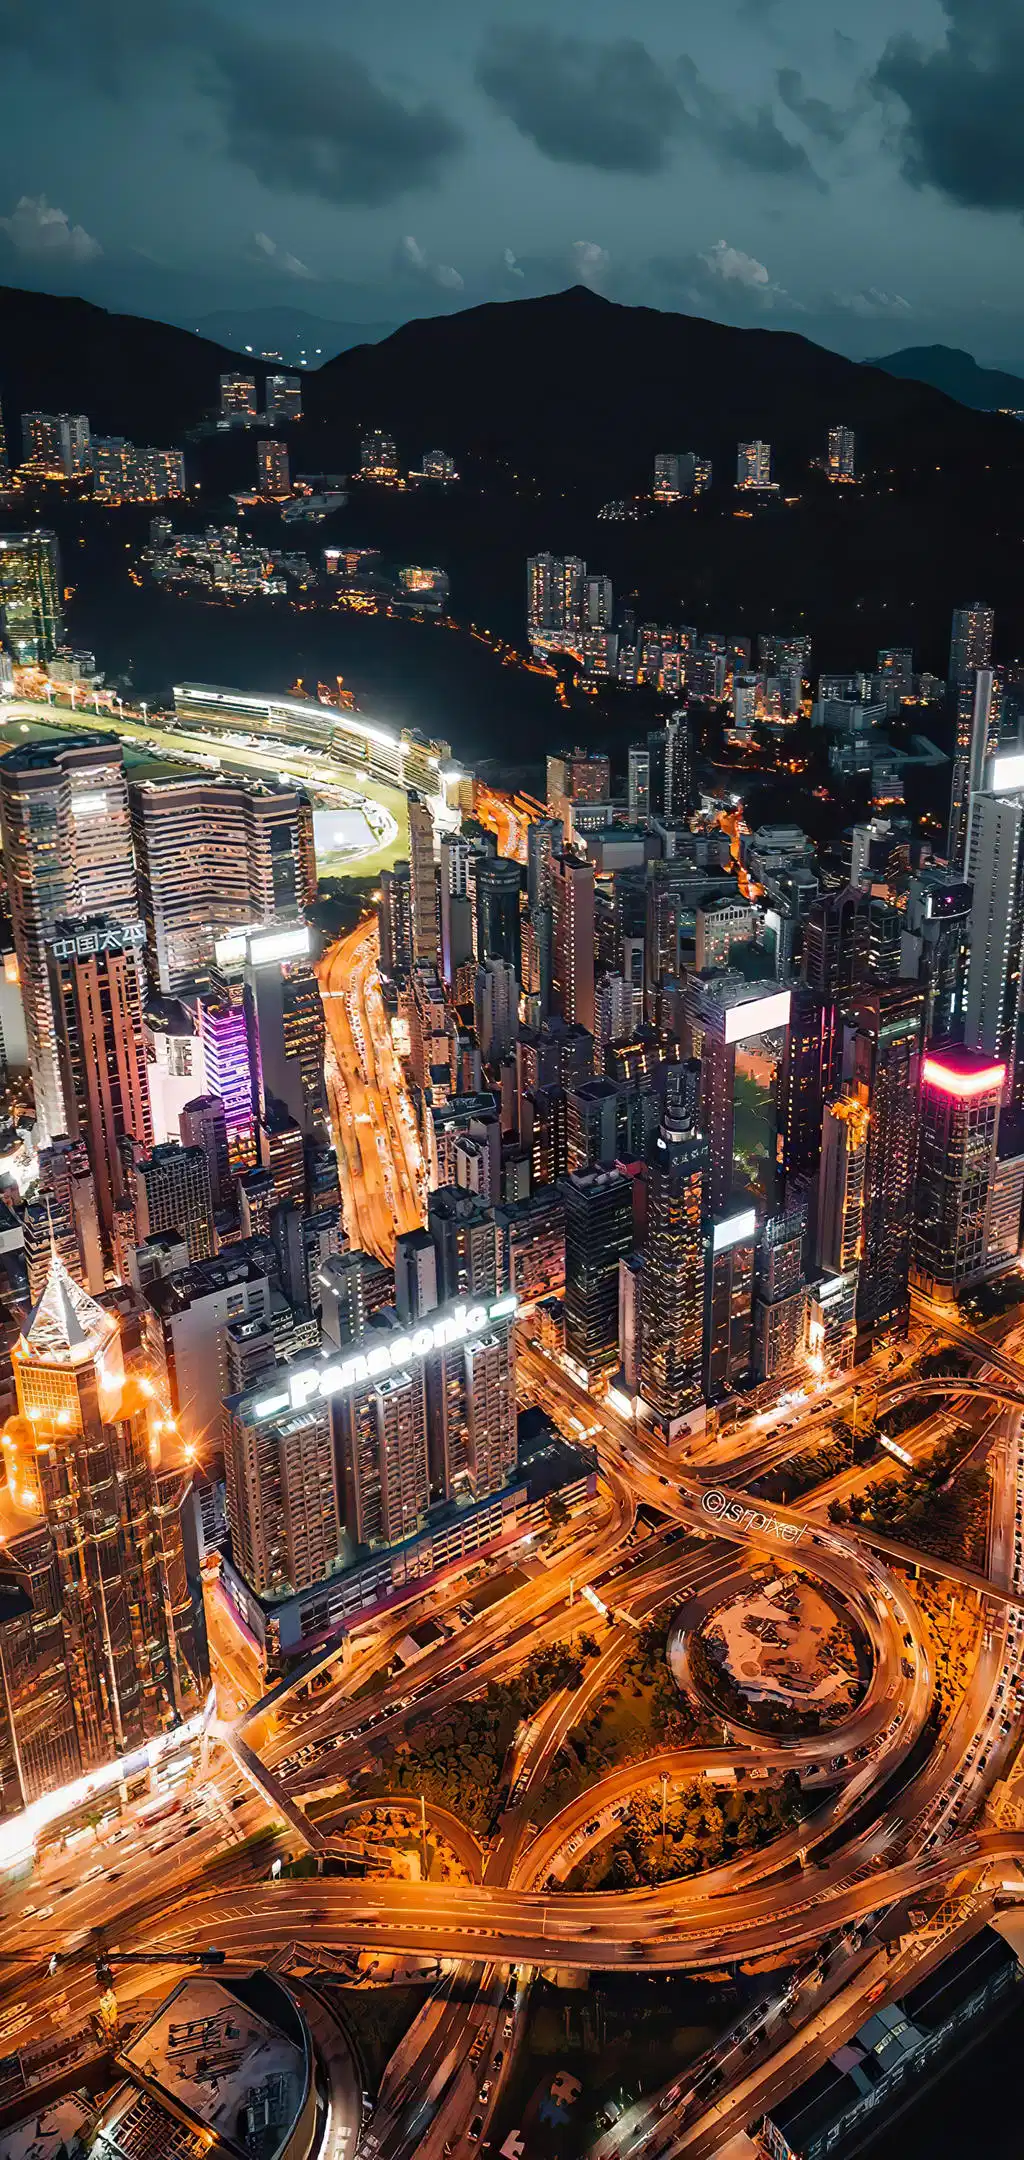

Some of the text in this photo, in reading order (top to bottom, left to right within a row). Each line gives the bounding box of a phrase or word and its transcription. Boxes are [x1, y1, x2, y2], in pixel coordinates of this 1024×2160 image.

[50, 923, 145, 958] 中国太平
[289, 1304, 487, 1409] Panasonic
